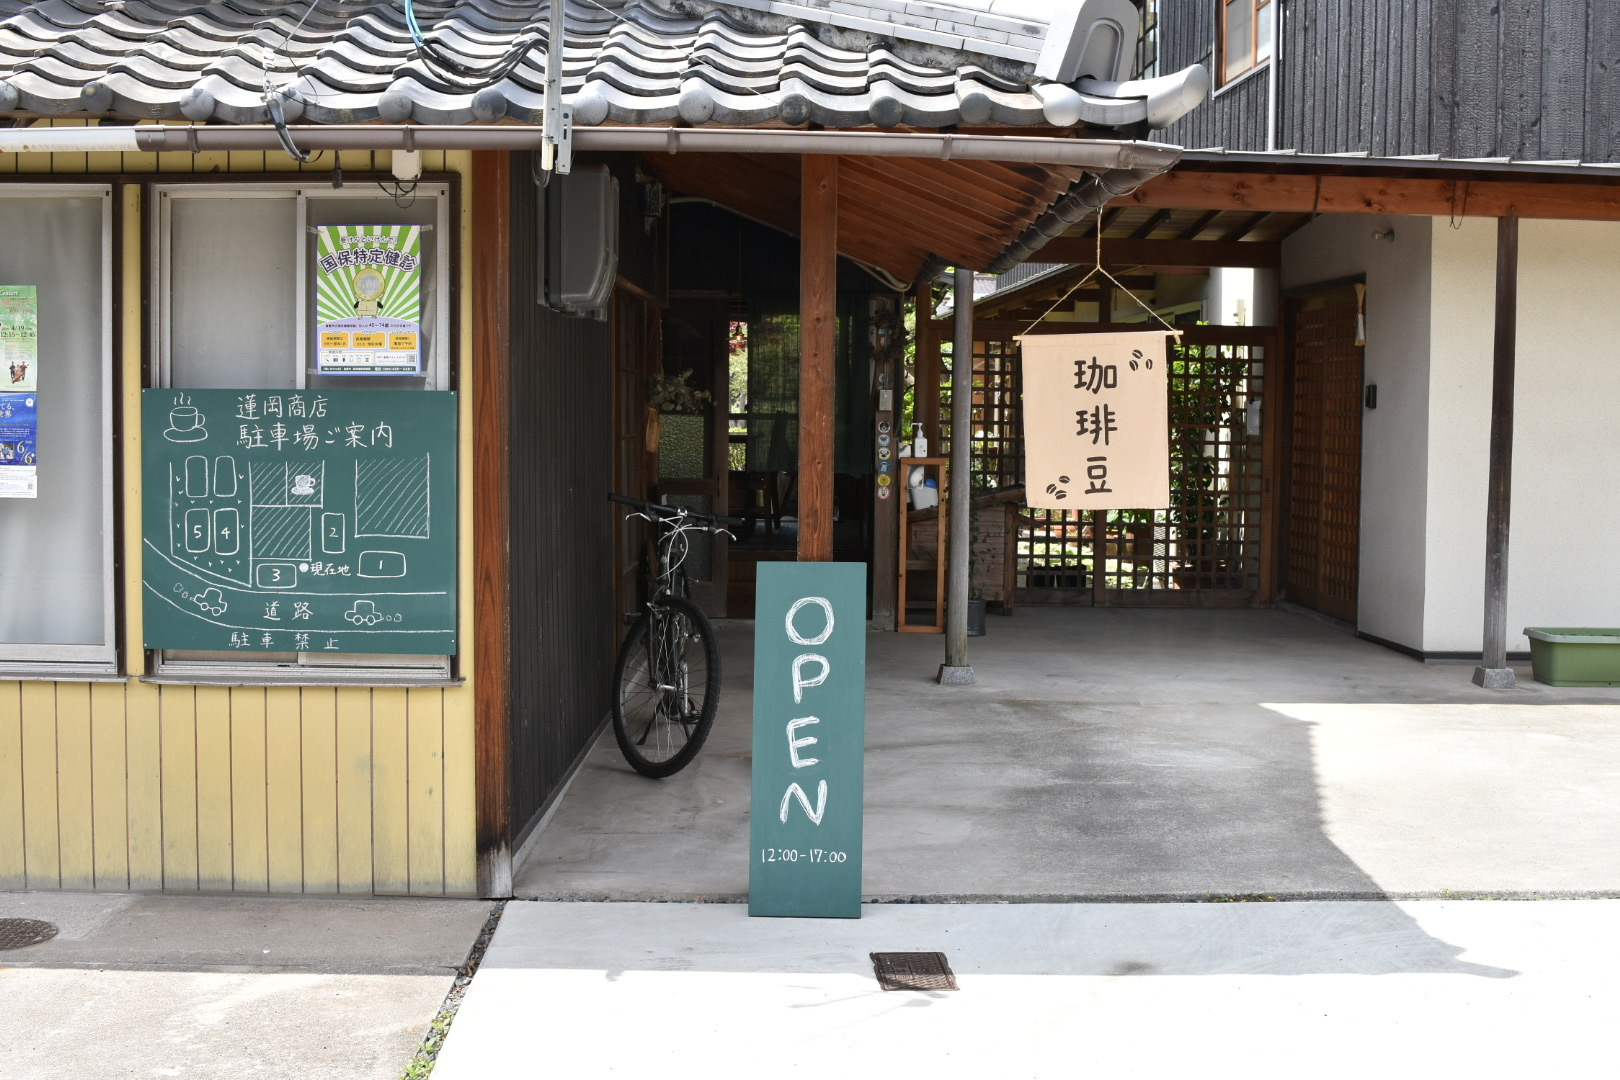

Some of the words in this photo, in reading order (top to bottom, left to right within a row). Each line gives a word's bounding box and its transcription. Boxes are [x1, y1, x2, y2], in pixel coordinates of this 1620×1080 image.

[319, 247, 417, 275] 国保特定健診
[235, 394, 329, 420] 蓮岡商店
[1073, 355, 1118, 495] 珈琲豆
[236, 421, 394, 451] 駐車場ご案内
[193, 525, 203, 539] 5
[221, 526, 231, 540] 4
[330, 527, 340, 539] 2
[310, 562, 352, 577] 現在地
[379, 559, 384, 570] 1
[271, 568, 281, 582] 3
[262, 601, 314, 621] 道路
[228, 632, 340, 651] 駐車禁止
[780, 596, 835, 827] OPEN
[761, 848, 848, 863] 12:00-17:00
